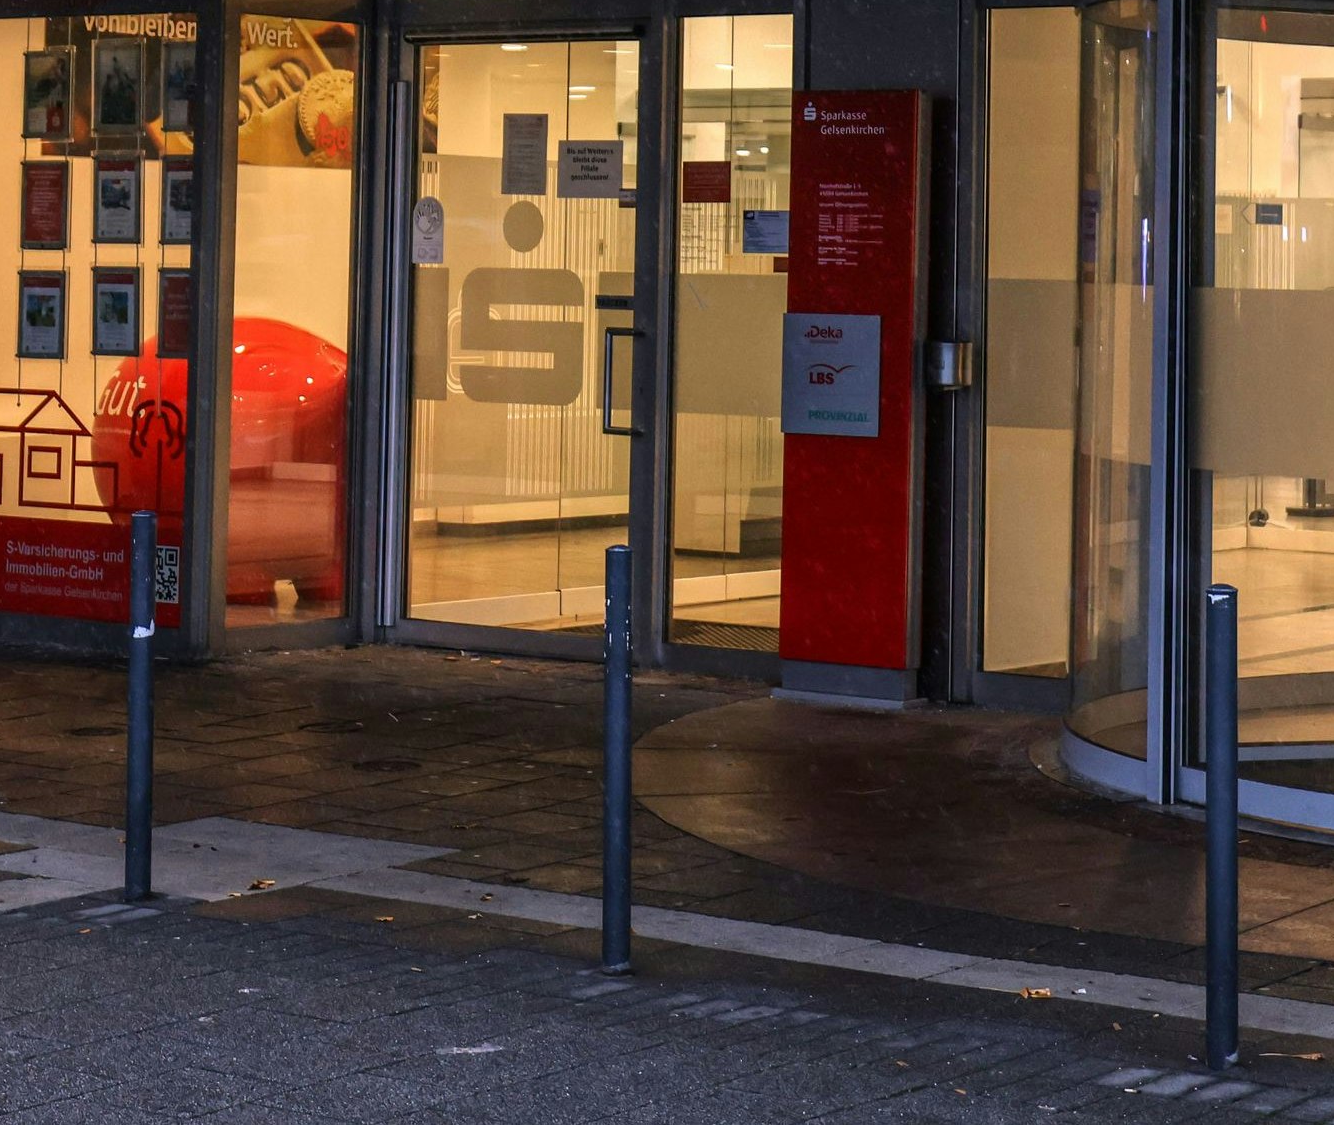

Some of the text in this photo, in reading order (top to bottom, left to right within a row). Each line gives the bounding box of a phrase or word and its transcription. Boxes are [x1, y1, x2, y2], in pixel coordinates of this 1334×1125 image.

[247, 21, 298, 49] Wert.
[820, 110, 867, 122] Sparkasse
[820, 124, 885, 135] Gelsenkirchen
[810, 326, 843, 338] Deka
[809, 372, 834, 385] LBS
[809, 410, 869, 422] PROVINZIAL
[103, 550, 124, 563] und
[6, 558, 104, 581] Immobilien-GmbH
[20, 583, 63, 599] Sparkasse
